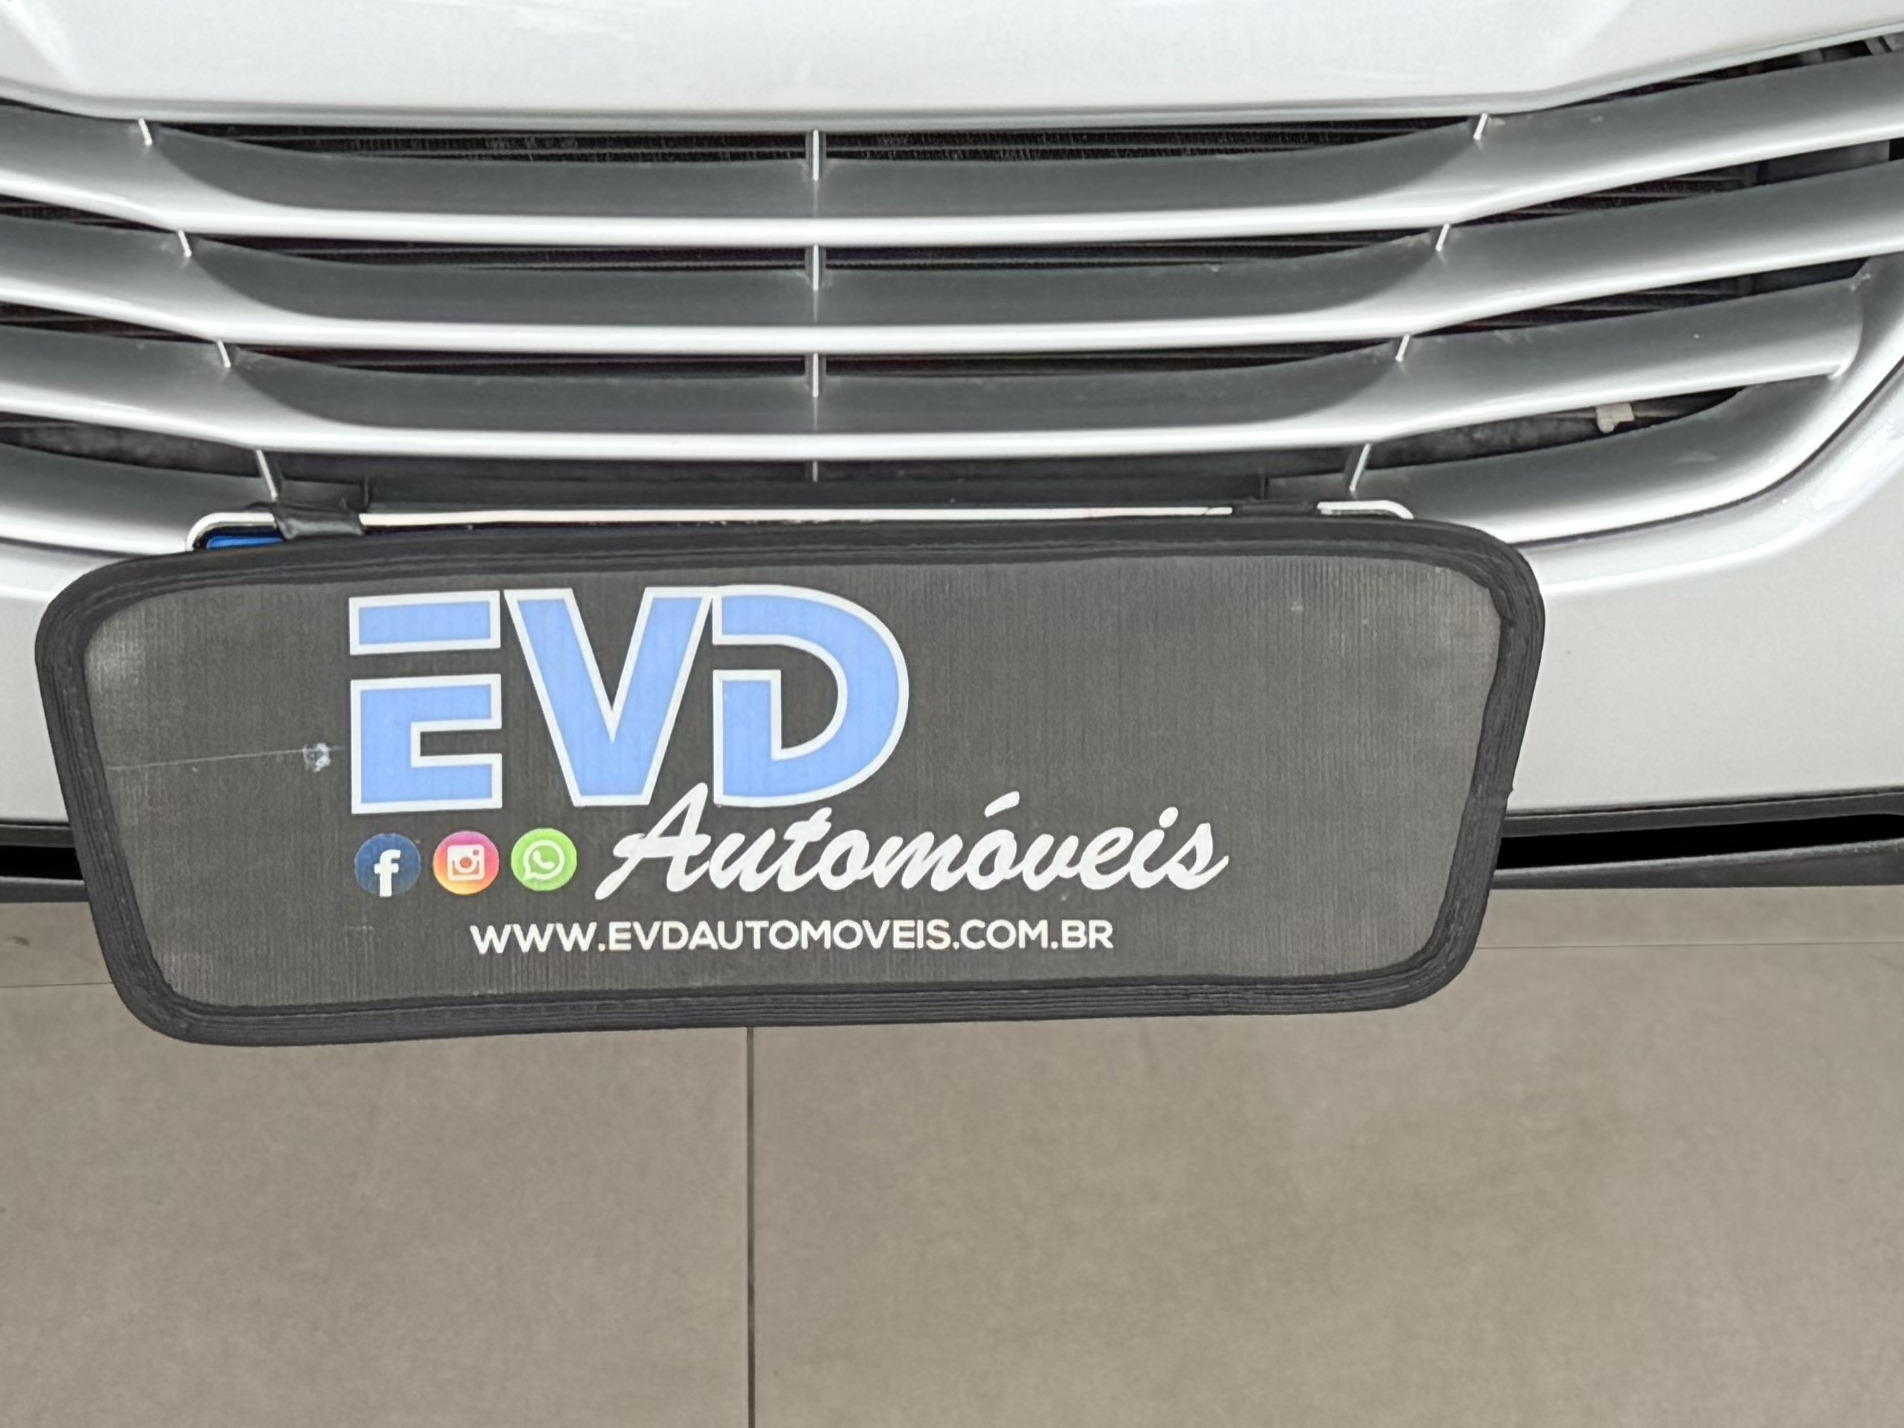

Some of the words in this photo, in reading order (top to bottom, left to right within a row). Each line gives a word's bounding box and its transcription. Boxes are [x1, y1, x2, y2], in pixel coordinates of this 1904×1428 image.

[349, 584, 910, 814] EVD
[594, 782, 1230, 901] Automóveis
[469, 918, 1115, 956] WWW.EVDAUTOMOVEIS.COM.BR
